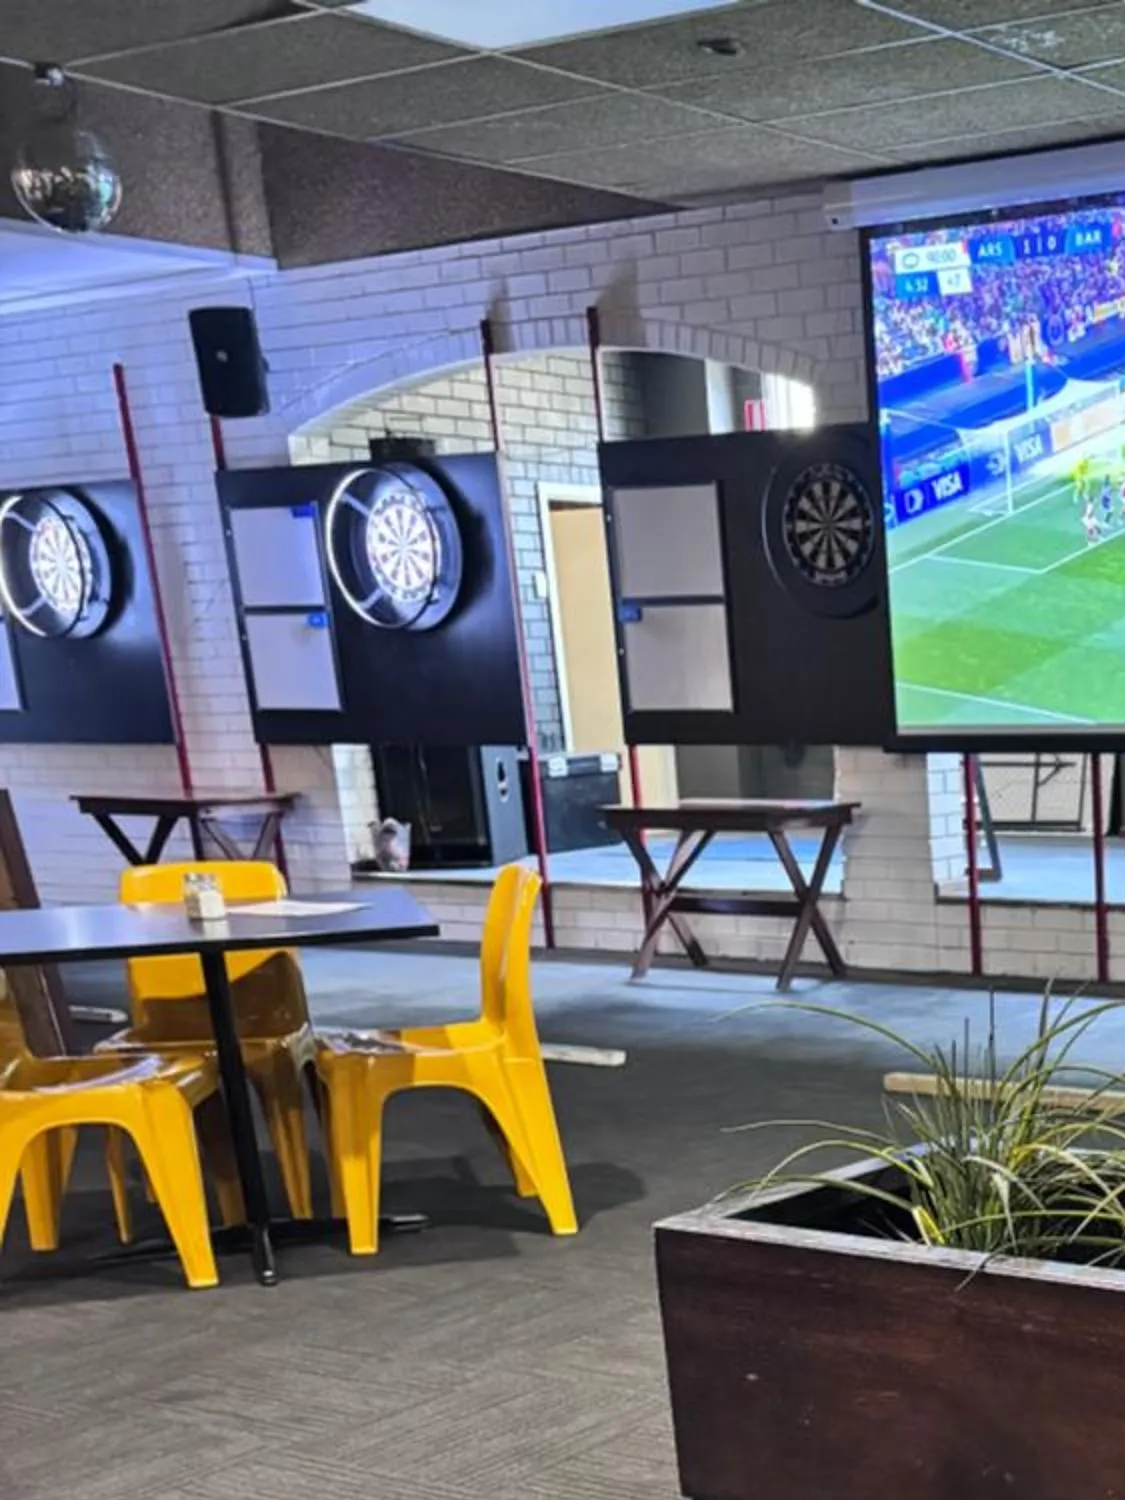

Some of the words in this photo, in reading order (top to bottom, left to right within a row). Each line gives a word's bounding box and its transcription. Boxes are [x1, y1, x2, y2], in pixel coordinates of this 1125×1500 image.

[978, 242, 1003, 258] ARS
[1075, 230, 1101, 246] BAR
[931, 471, 963, 500] VISA
